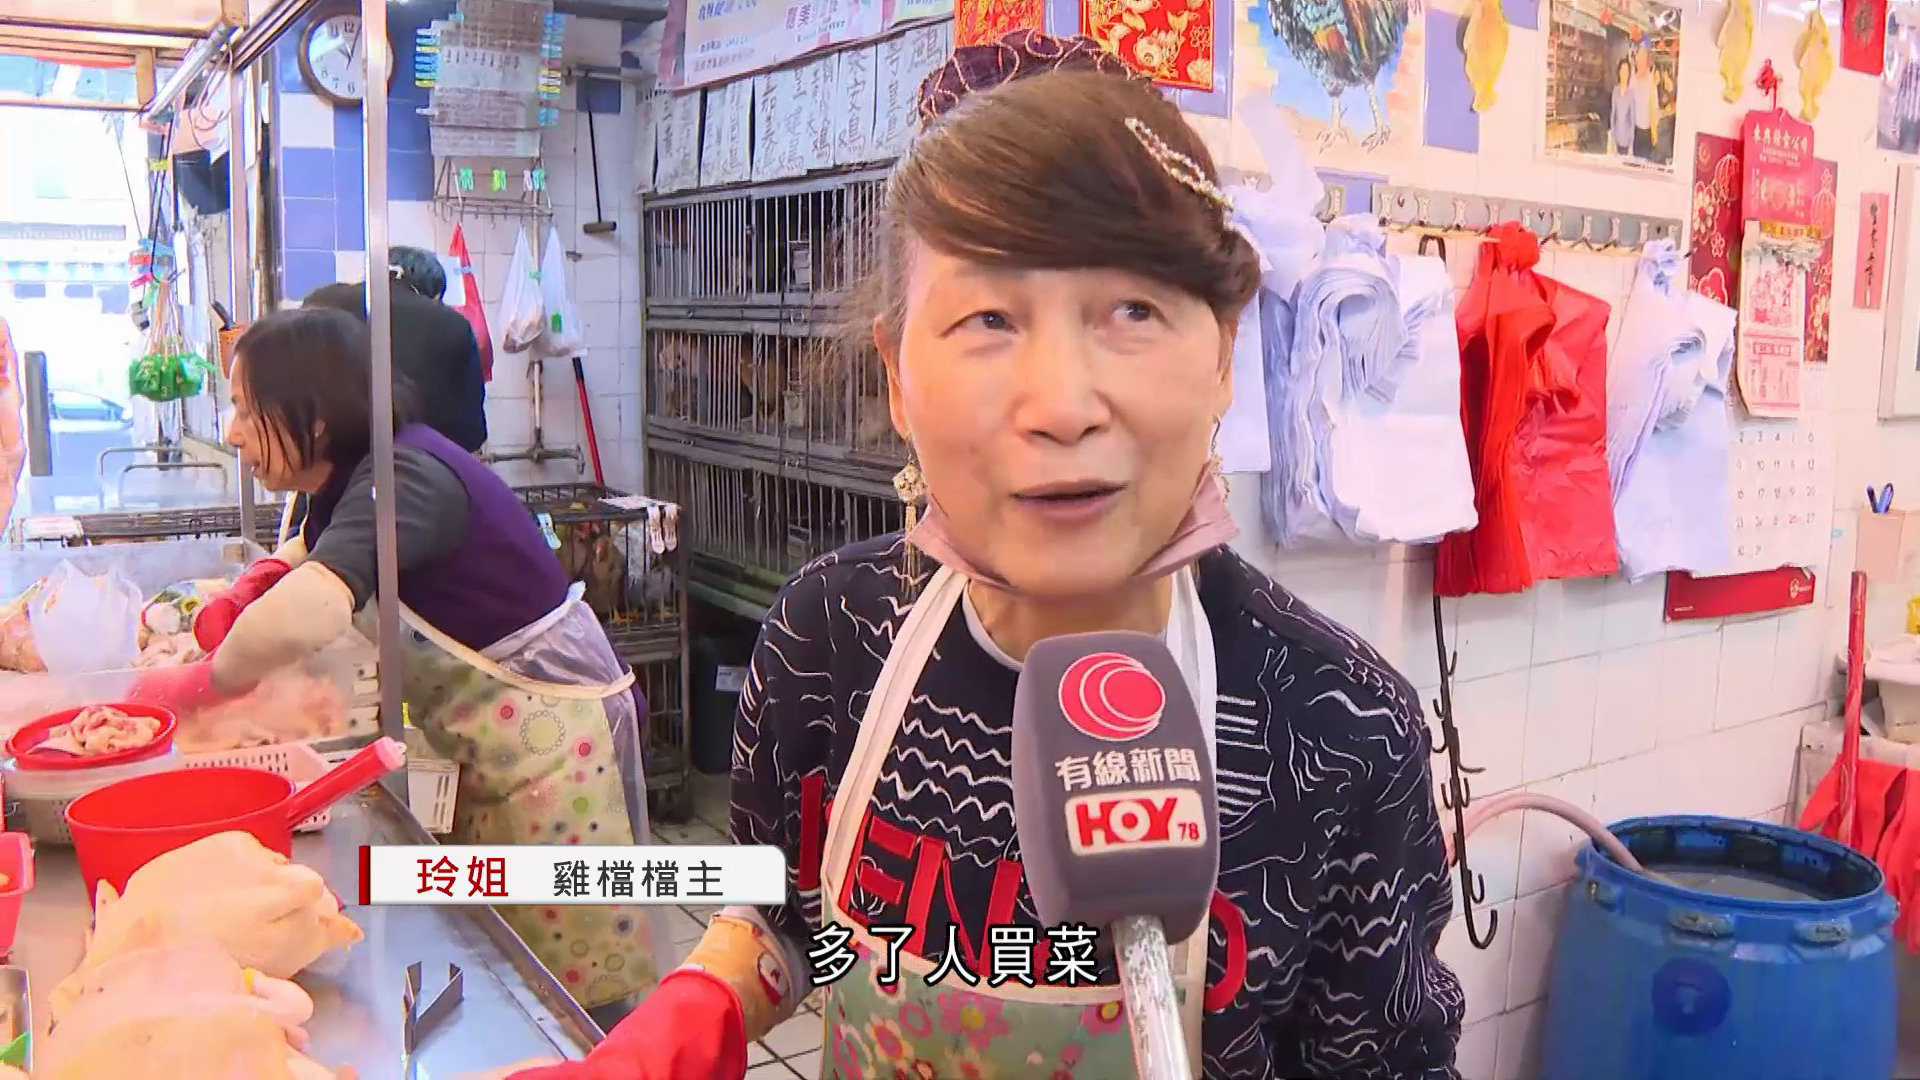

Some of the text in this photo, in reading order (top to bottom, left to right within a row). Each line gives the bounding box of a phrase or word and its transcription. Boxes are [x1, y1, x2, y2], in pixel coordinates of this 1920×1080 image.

[344, 21, 355, 33] 12
[1055, 748, 1201, 791] 有線新聞
[1076, 798, 1199, 847] HOY 78
